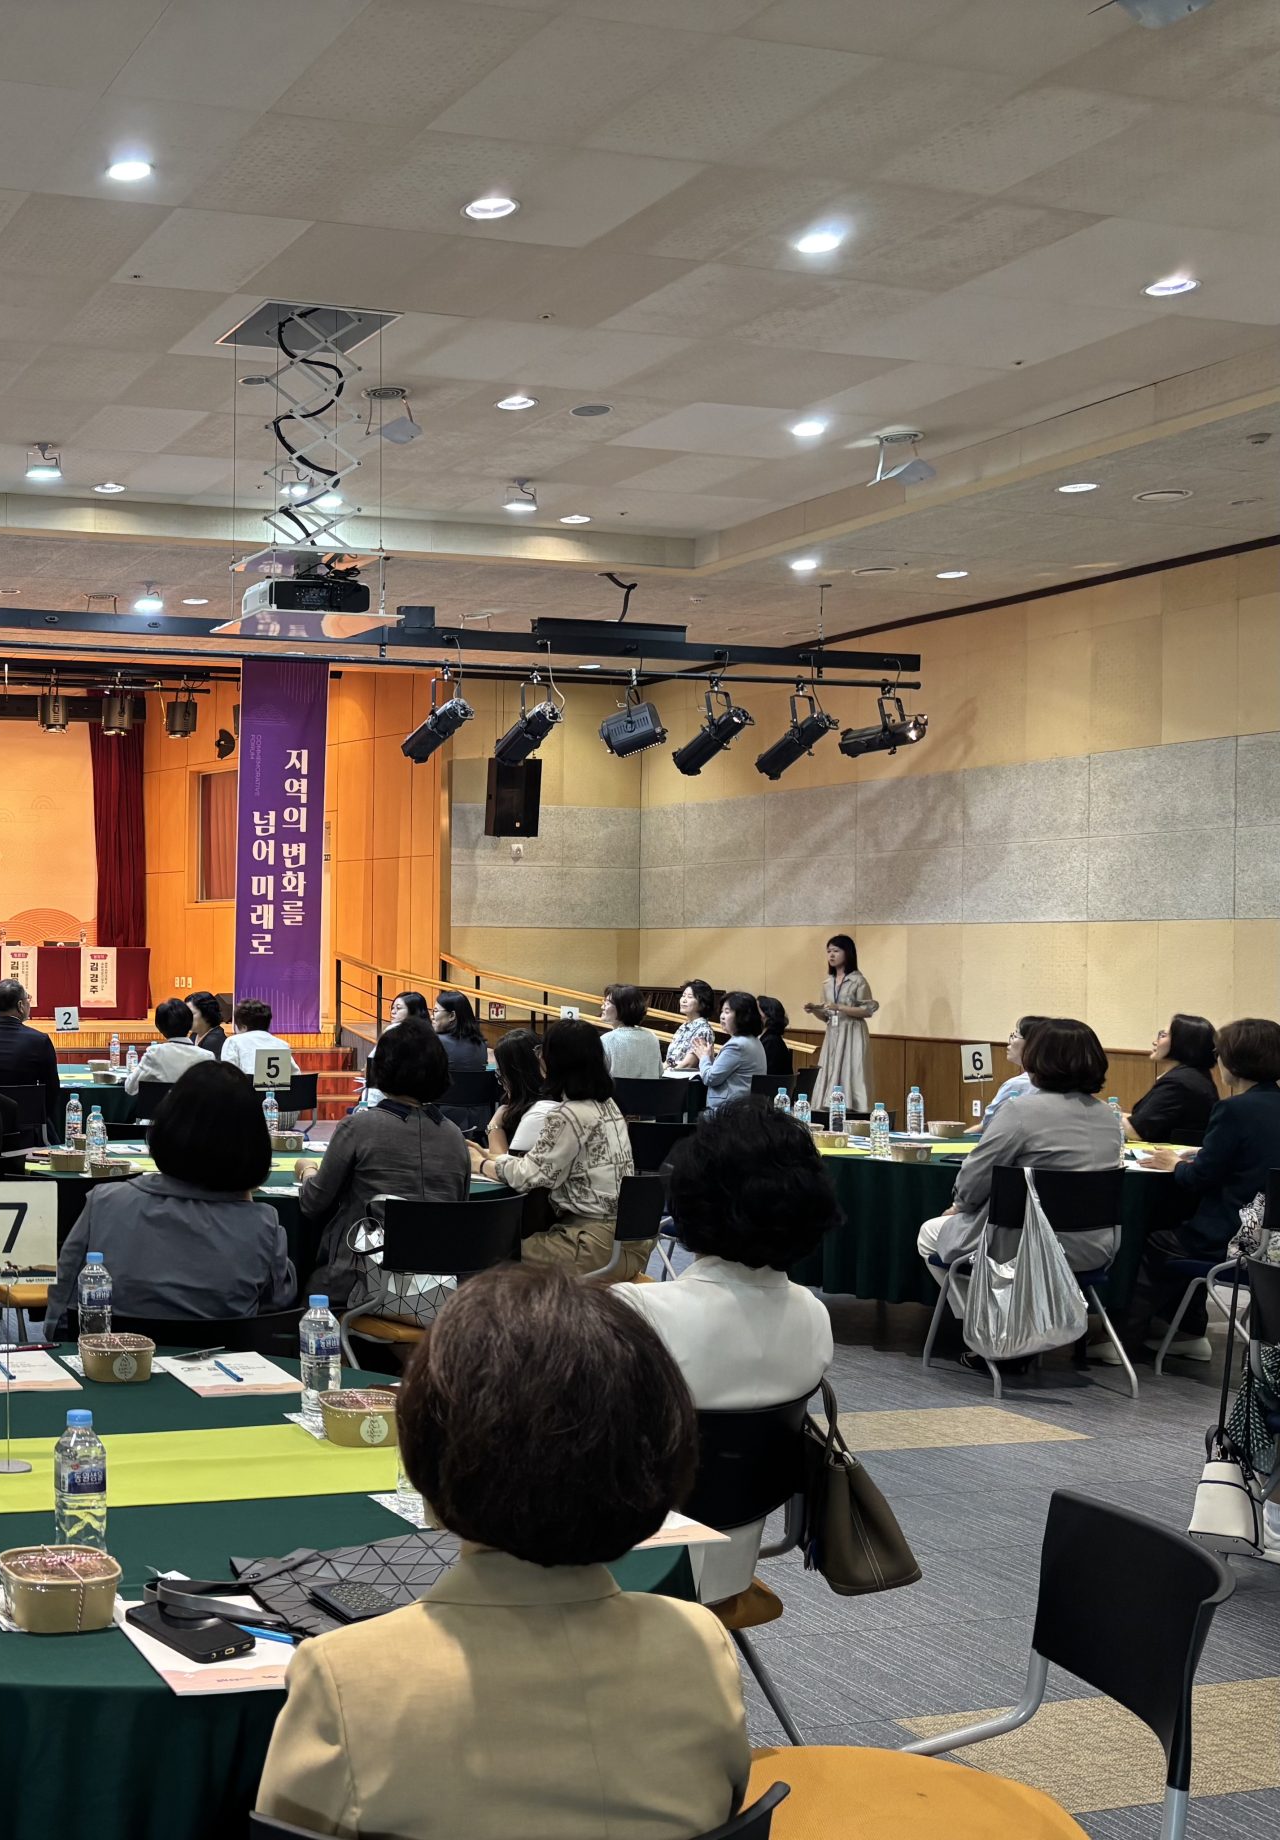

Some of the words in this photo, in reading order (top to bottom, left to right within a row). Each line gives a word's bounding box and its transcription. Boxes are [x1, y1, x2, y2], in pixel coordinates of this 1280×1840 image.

[282, 749, 309, 833] 지역의
[251, 810, 276, 865] 넘어
[280, 842, 306, 926] 변화를
[249, 874, 275, 956] 미래로
[89, 962, 99, 994] 김경주
[62, 1011, 72, 1025] 2
[266, 1056, 280, 1078] 5
[972, 1051, 984, 1071] 6
[74, 1471, 103, 1483] 동원샘물
